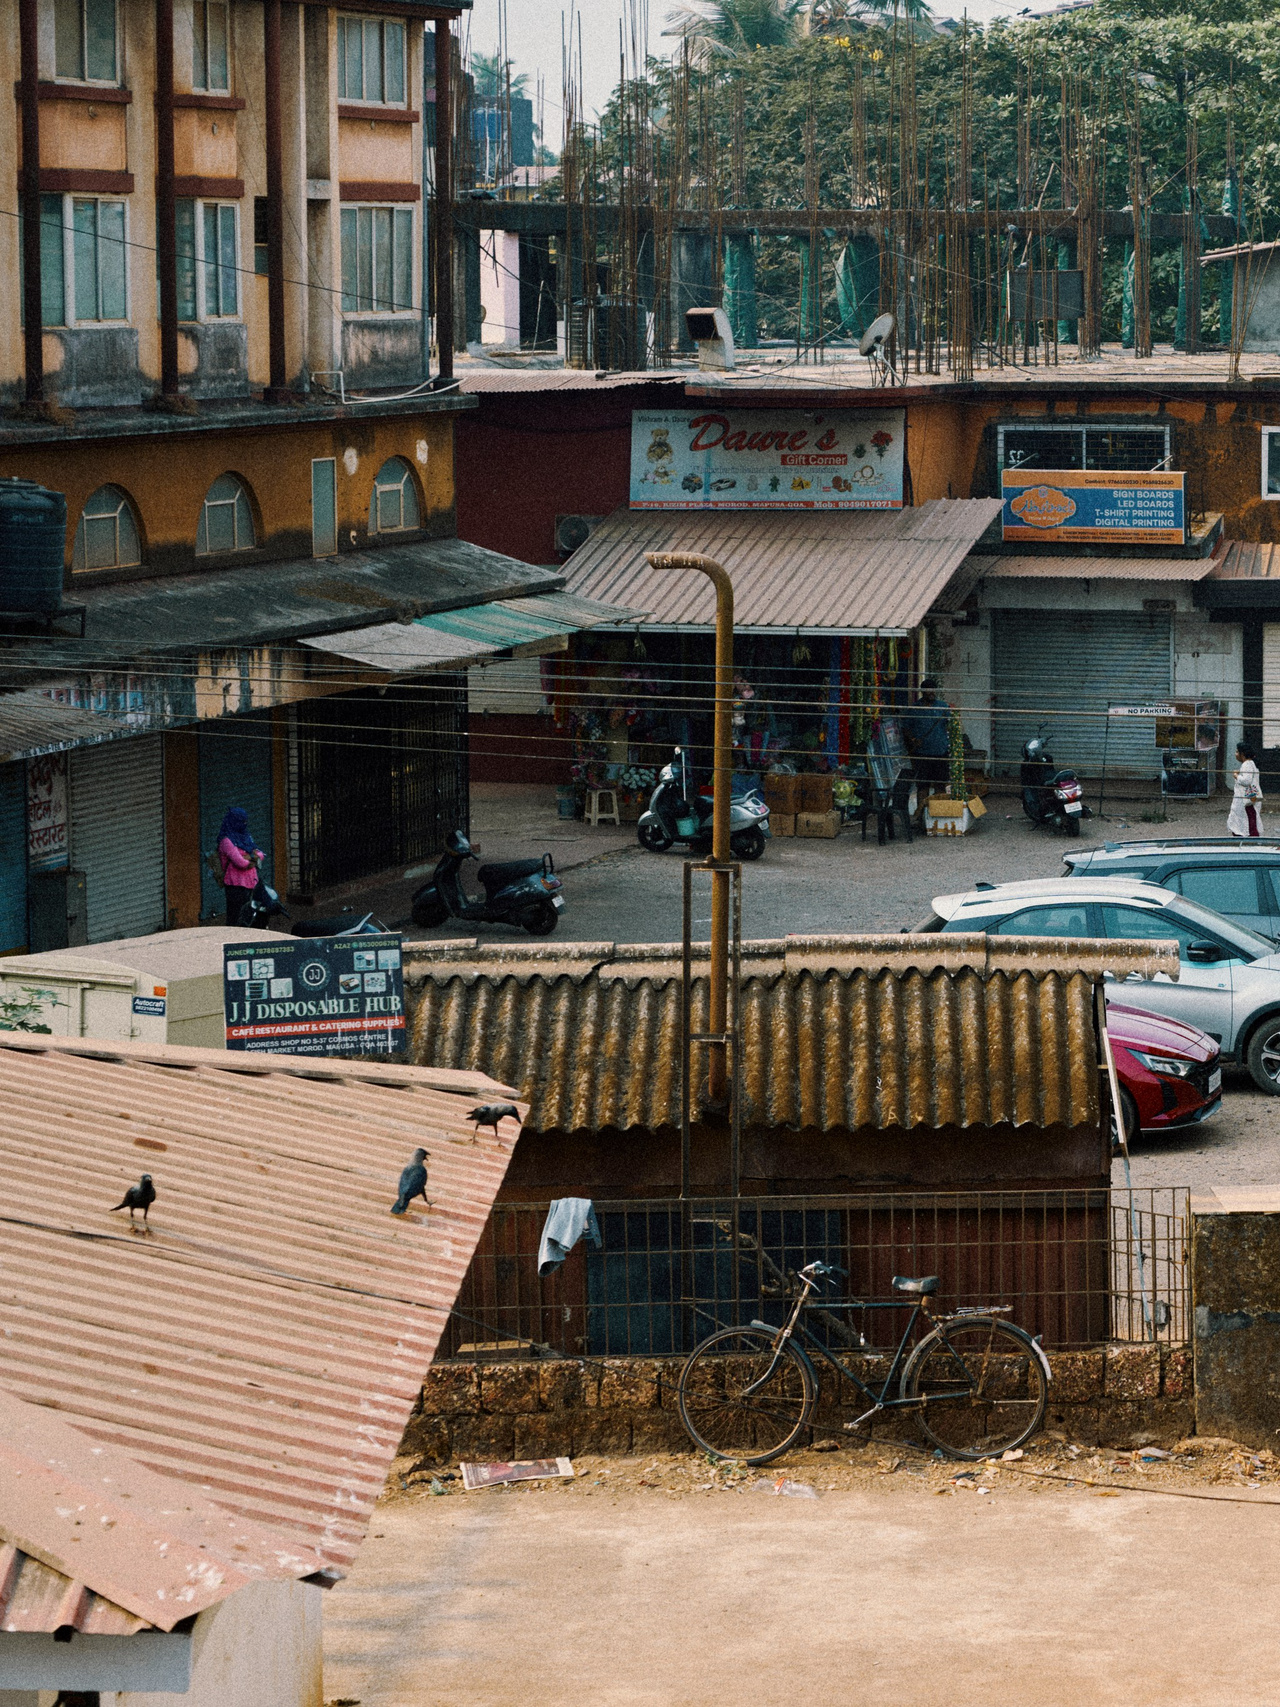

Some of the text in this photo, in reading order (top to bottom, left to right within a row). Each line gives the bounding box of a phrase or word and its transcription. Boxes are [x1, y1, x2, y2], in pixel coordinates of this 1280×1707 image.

[786, 455, 846, 464] Gift Corner
[1118, 500, 1174, 508] LED BOARDS
[1132, 519, 1174, 527] PRINTING
[309, 969, 320, 980] JJ
[135, 999, 164, 1007] Autocraft
[230, 996, 401, 1022] J J DISPOSABLE HUB
[232, 1027, 254, 1036] CAFÉ
[255, 1024, 310, 1034] RESTAURANT
[319, 1021, 361, 1030] CATERING
[363, 1019, 400, 1028] SUPPLIES
